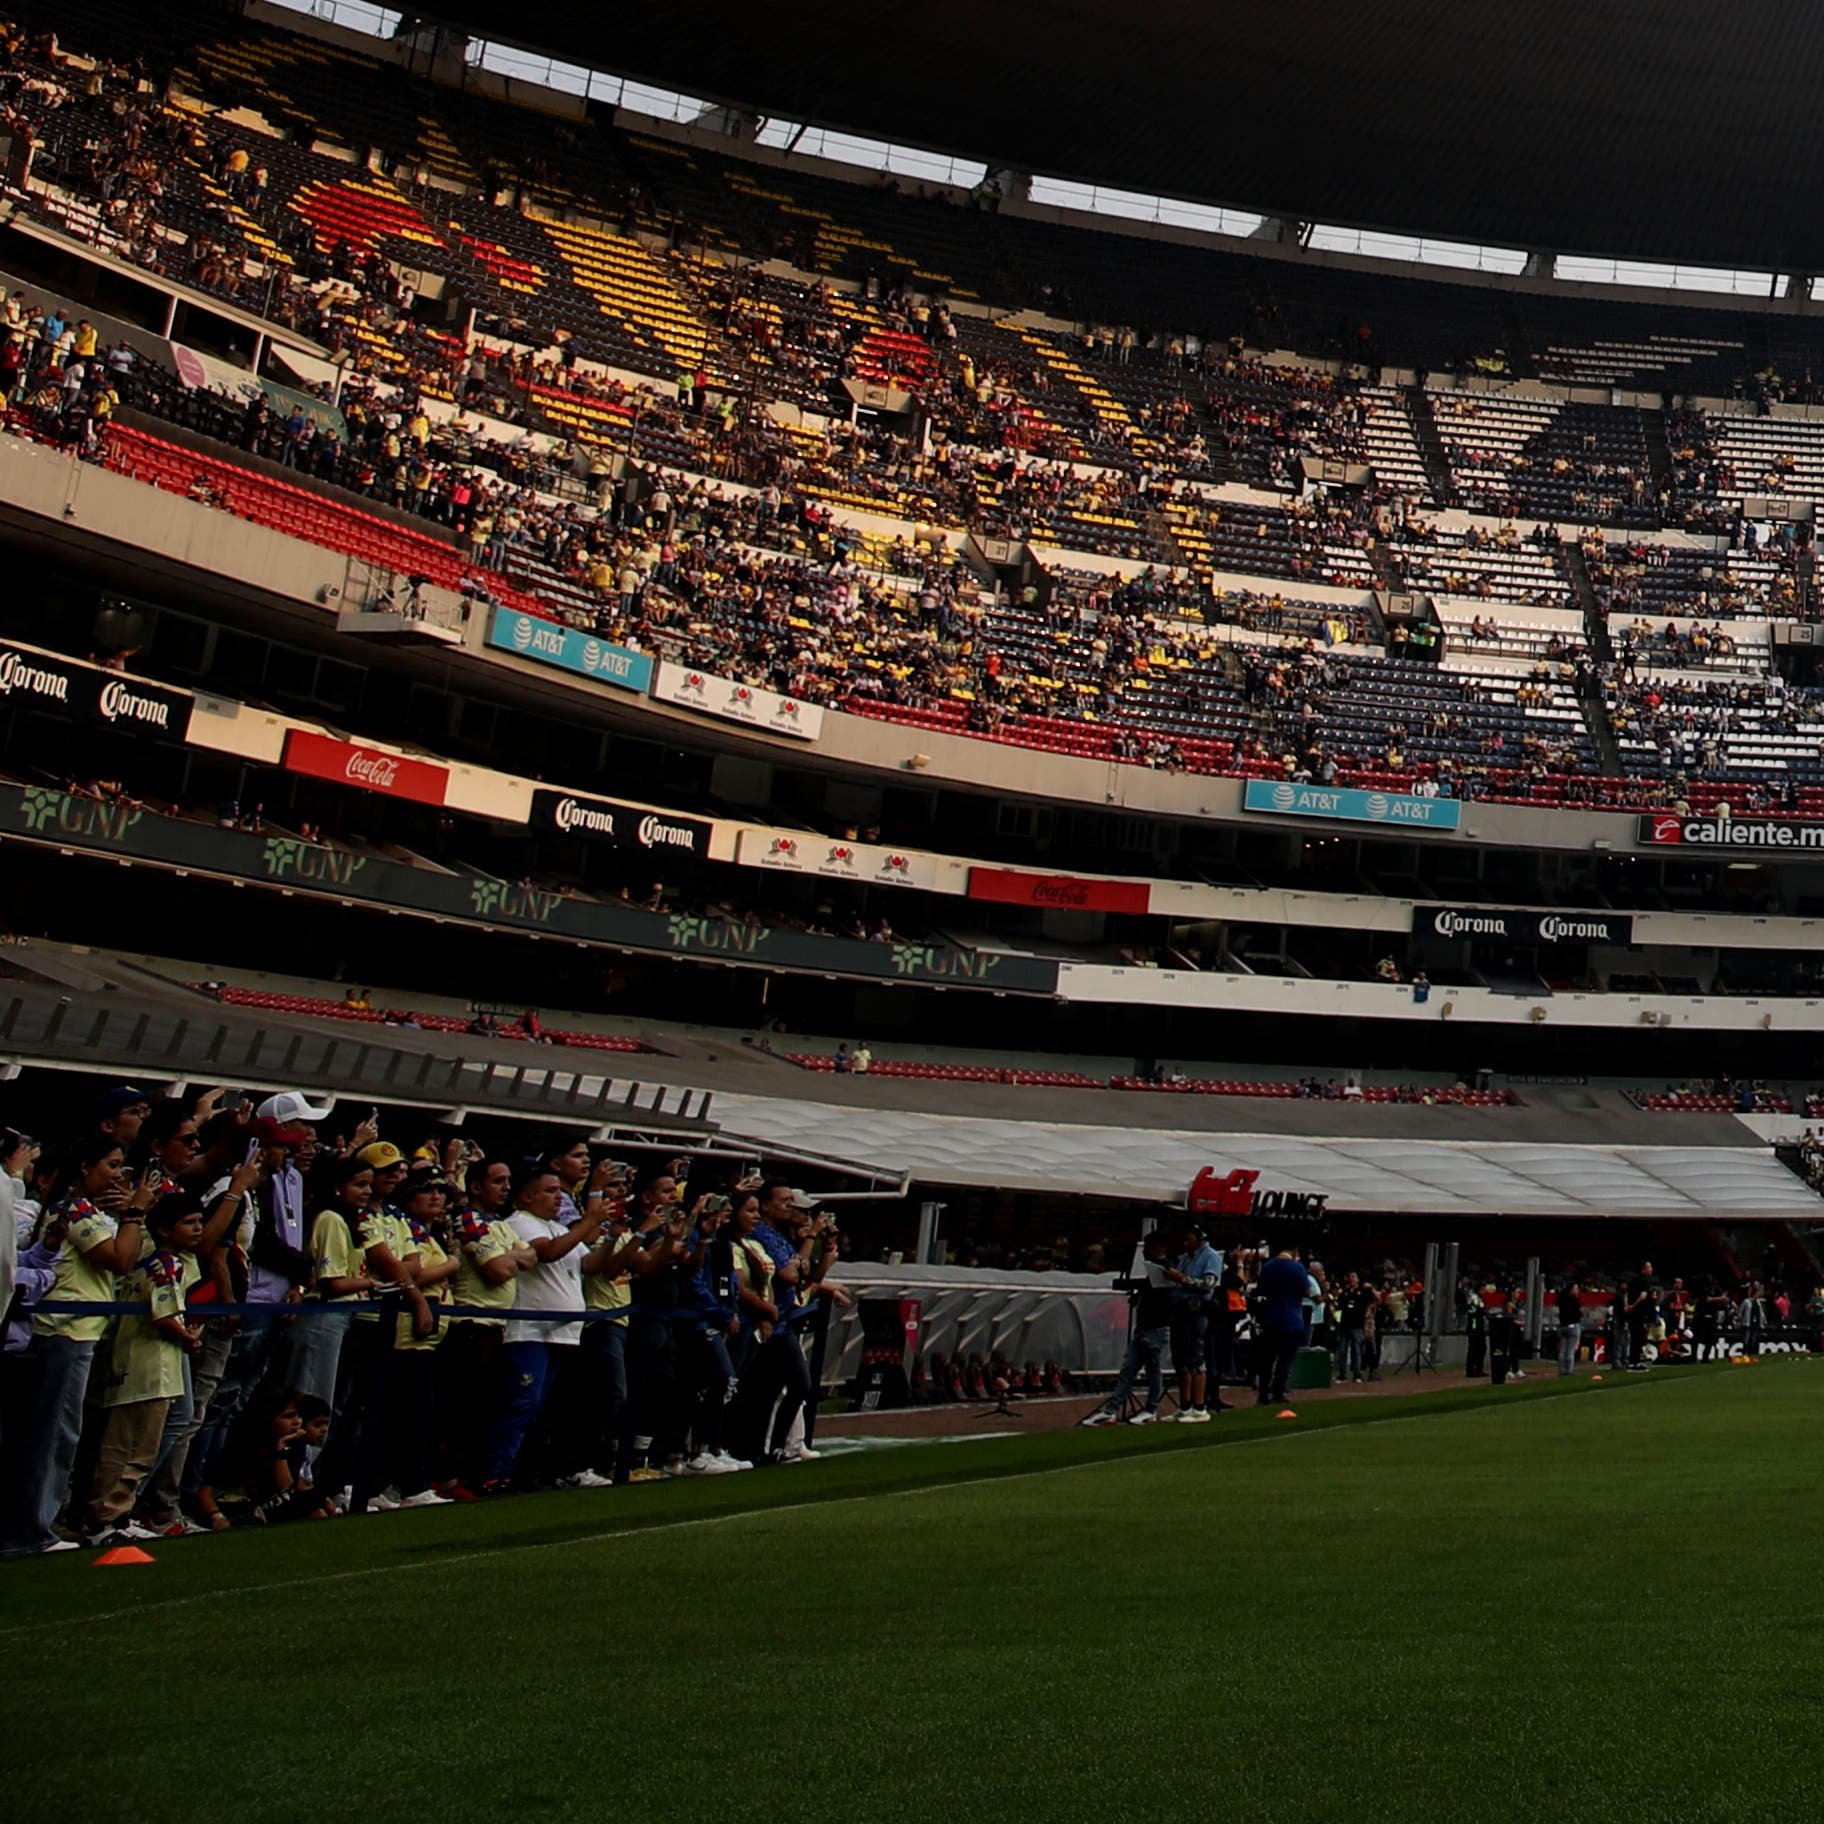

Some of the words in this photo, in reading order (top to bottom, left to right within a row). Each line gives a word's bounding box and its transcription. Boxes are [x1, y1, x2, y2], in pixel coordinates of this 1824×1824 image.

[532, 629, 566, 657] AT&T
[601, 650, 633, 676] AT&T
[0, 652, 69, 702] Corona
[100, 680, 169, 727] Corona
[59, 795, 142, 841] GNP
[555, 798, 613, 832] Corona
[638, 815, 694, 849] Corona
[1298, 791, 1341, 810] AT&T
[1391, 801, 1434, 821] AT&T
[296, 843, 366, 885] GNP
[499, 885, 562, 921] GNP
[699, 914, 769, 953] GNP
[1435, 911, 1506, 938] Corona
[1539, 916, 1609, 942] Corona
[926, 948, 1000, 978] GNP
[1254, 1190, 1329, 1218] LOUNGE
